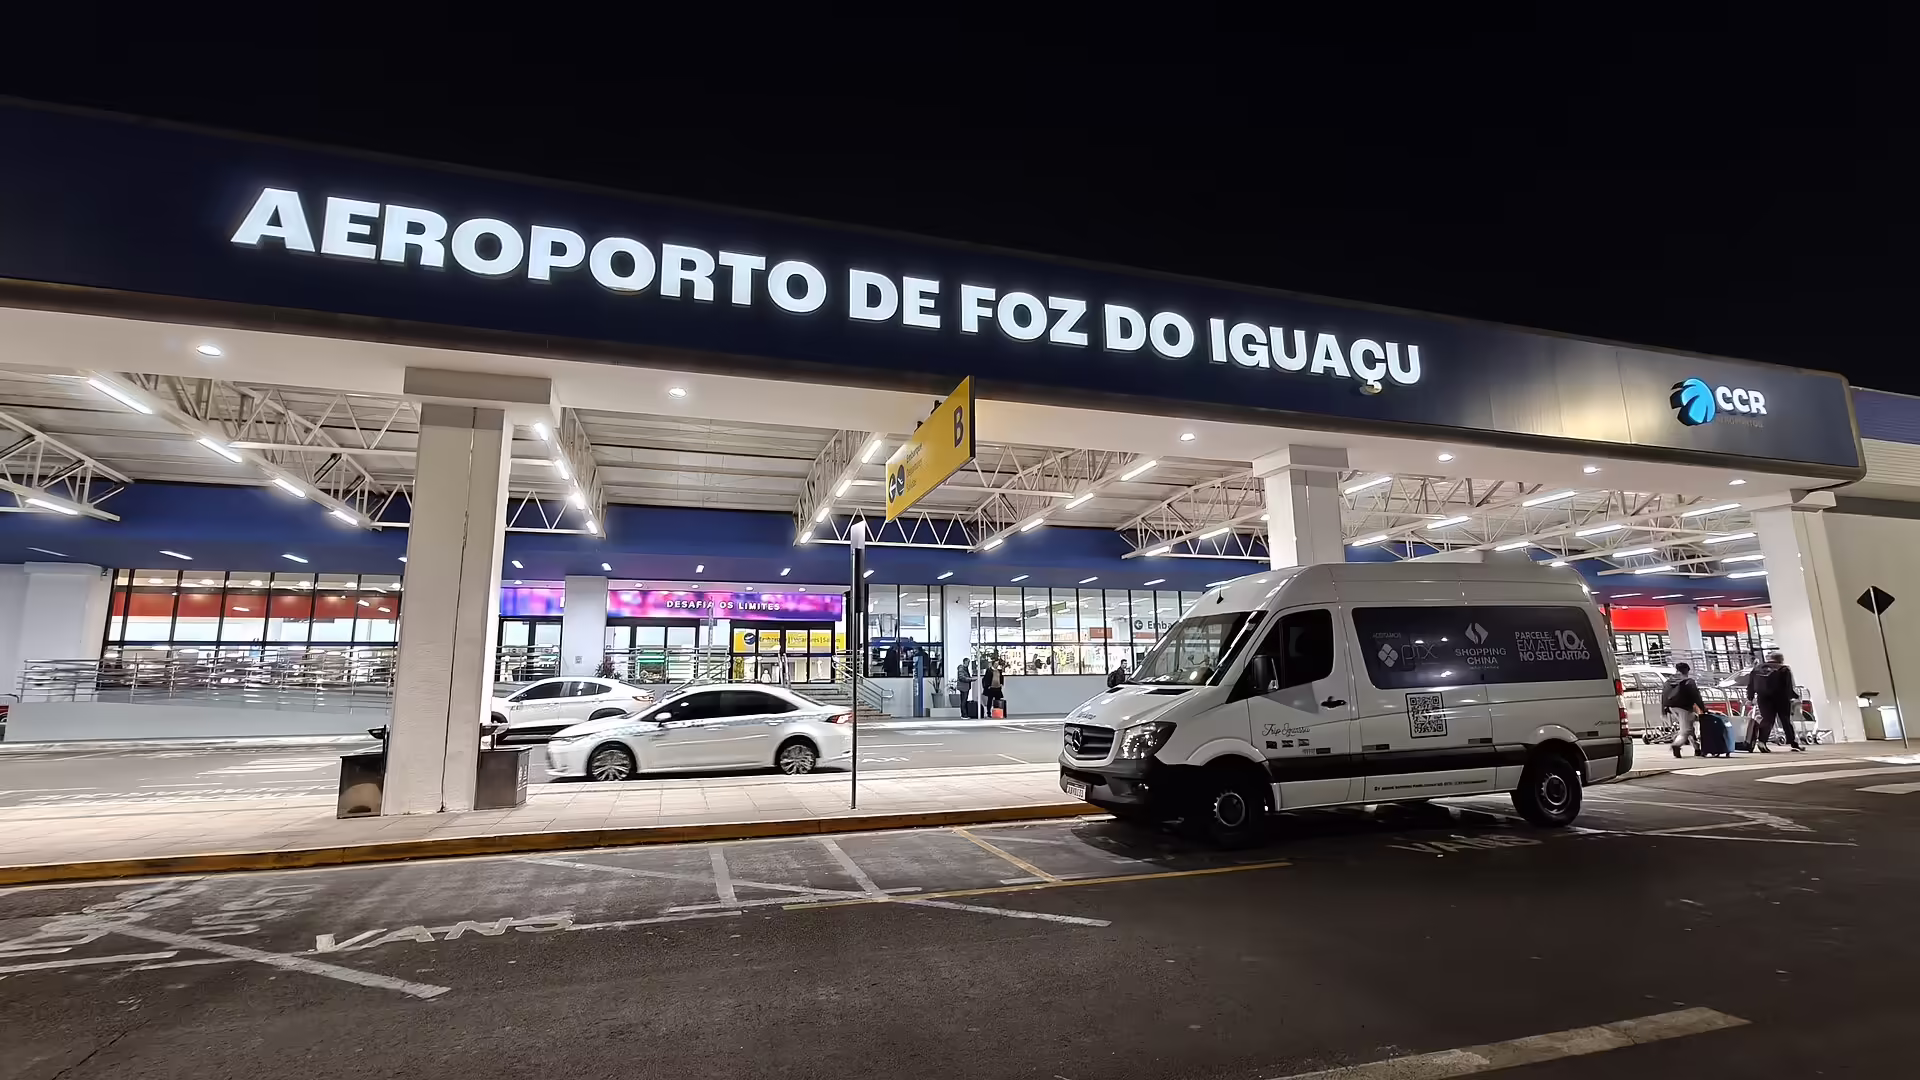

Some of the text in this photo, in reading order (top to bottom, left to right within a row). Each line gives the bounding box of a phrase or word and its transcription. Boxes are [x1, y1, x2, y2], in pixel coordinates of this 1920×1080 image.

[230, 187, 1421, 394] AEROPORTO DE FOZ DO IGUAÇU
[1716, 386, 1767, 415] CCR
[953, 404, 964, 448] B
[666, 600, 781, 611] DESAFIA OS LIMITES
[1147, 620, 1173, 630] Emba
[1454, 647, 1507, 657] SHOPPING
[1519, 651, 1535, 662] NO
[1536, 651, 1554, 661] SEU
[1466, 656, 1499, 665] CHINA
